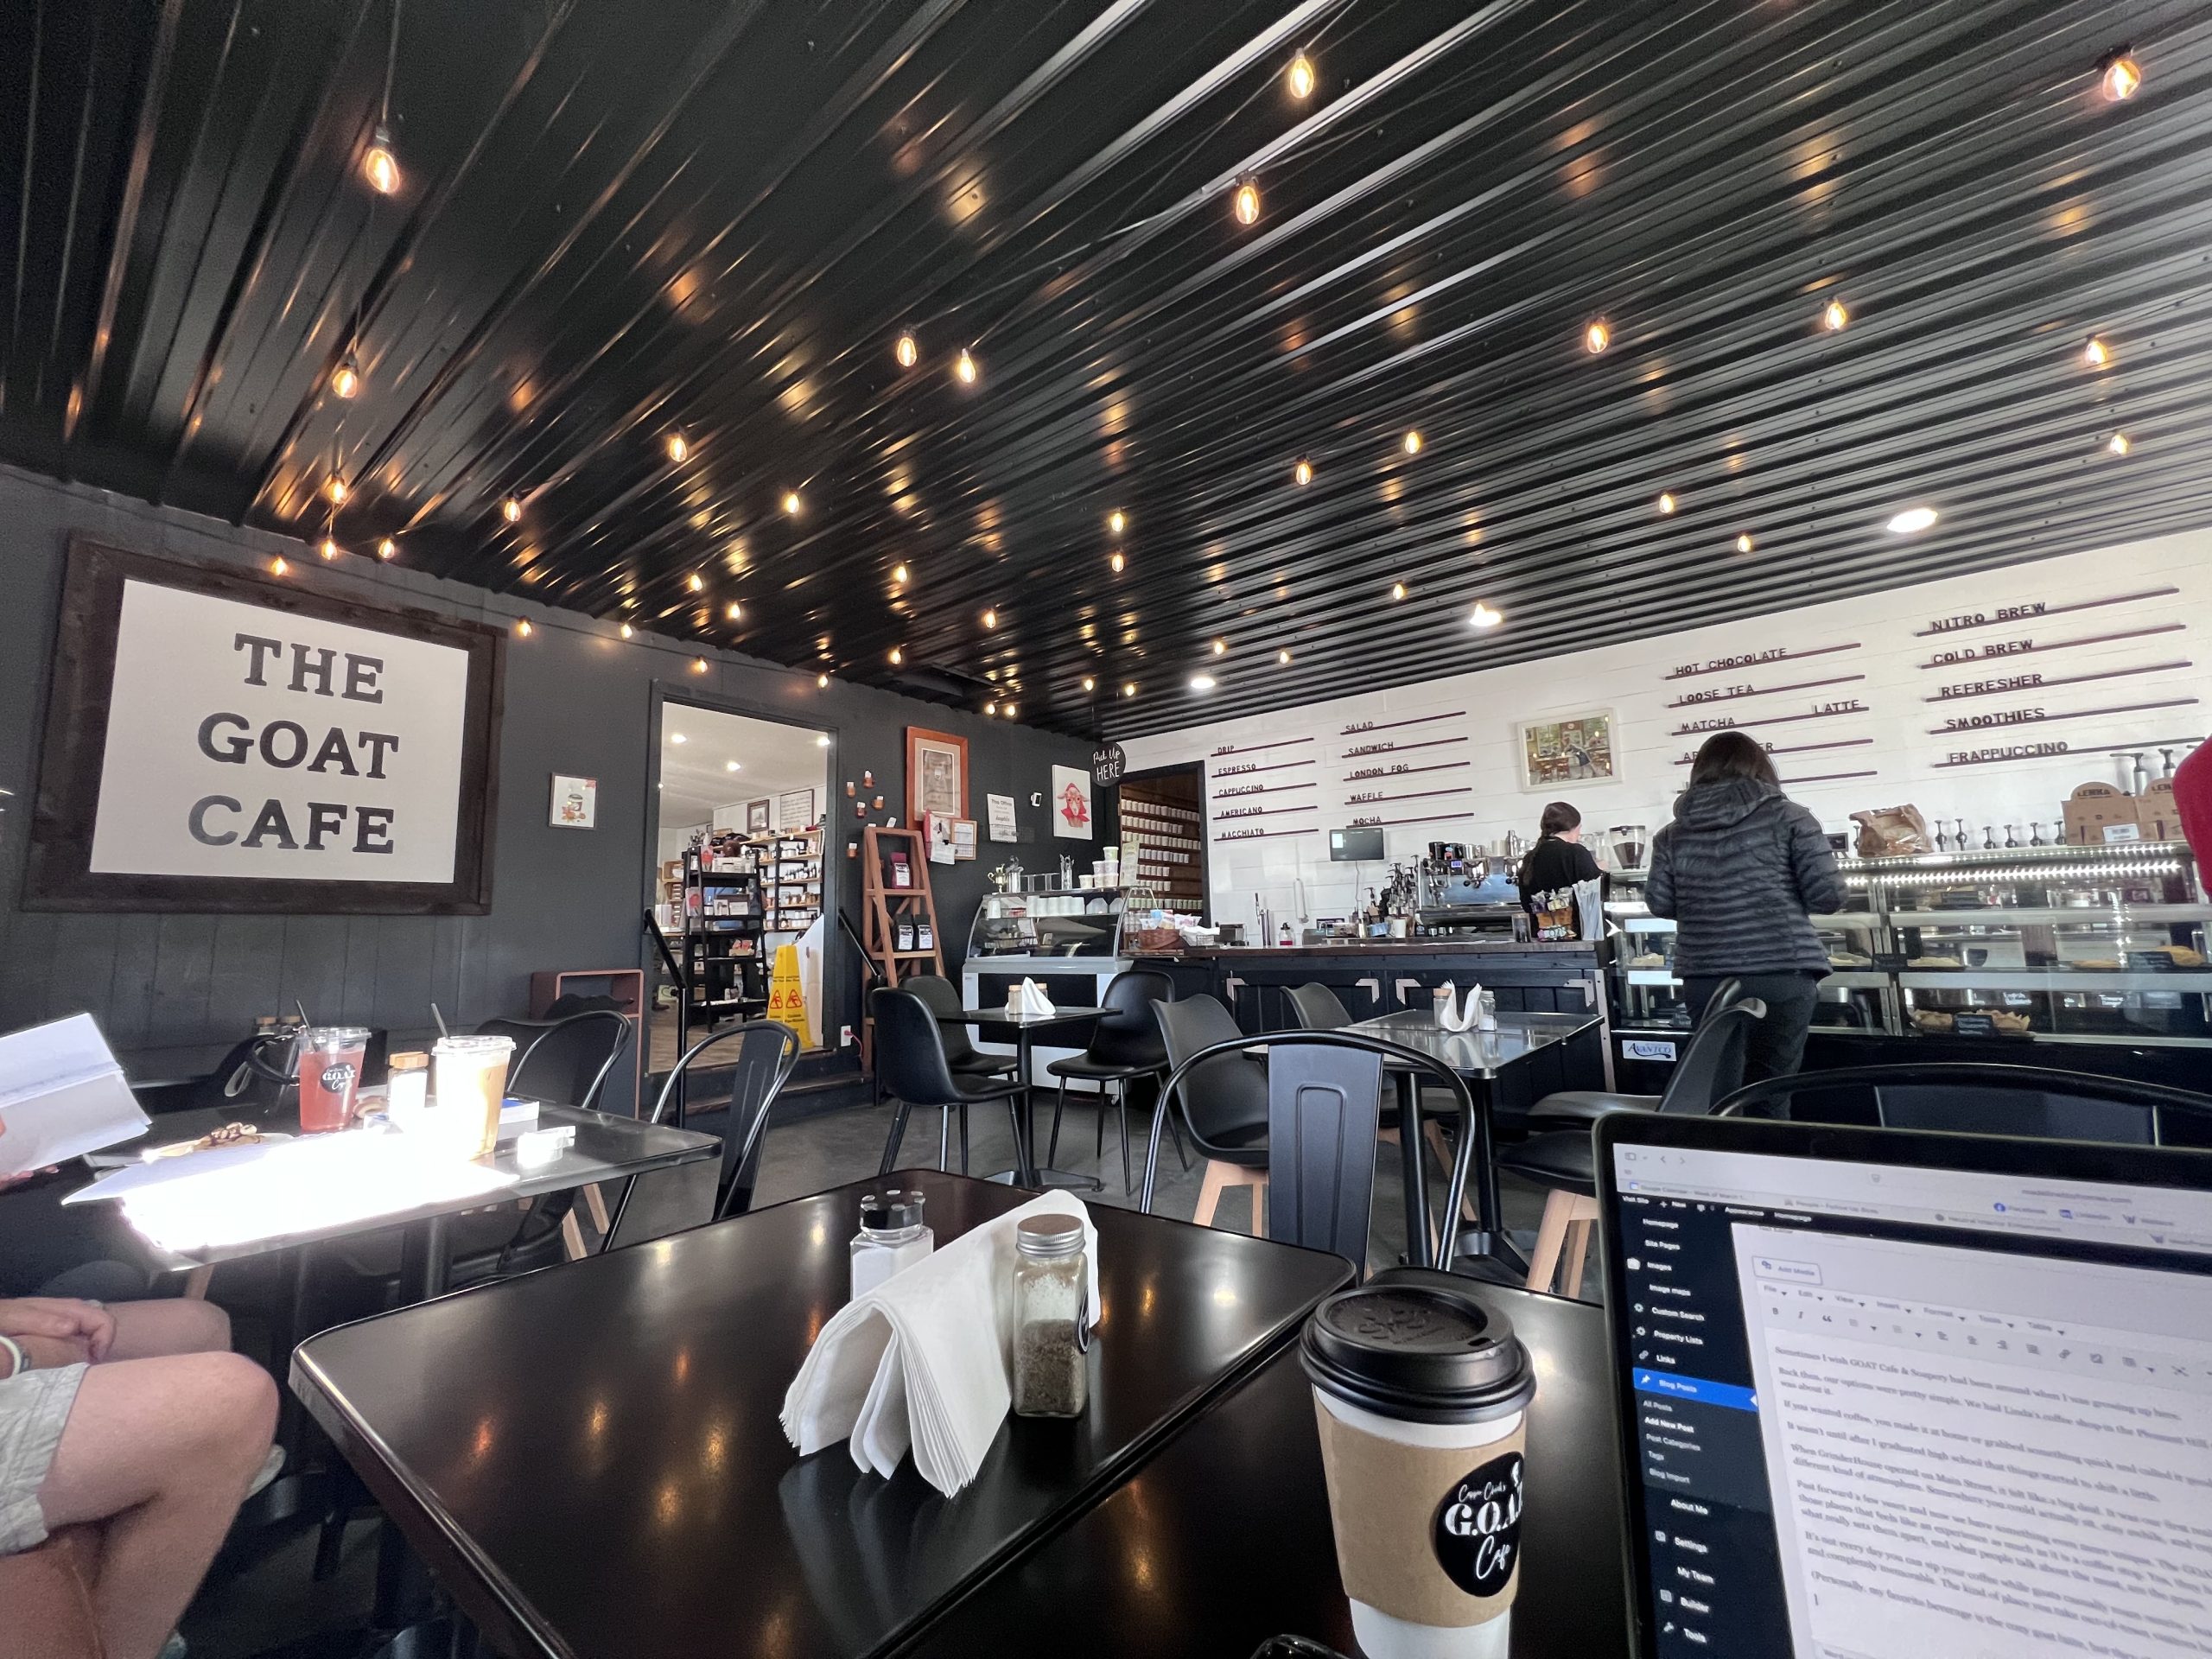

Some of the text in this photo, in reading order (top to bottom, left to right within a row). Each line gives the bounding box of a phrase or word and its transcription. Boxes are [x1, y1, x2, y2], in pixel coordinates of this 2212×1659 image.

[1931, 602, 2046, 632] NITRO BREW
[1933, 639, 2033, 664] COLD BREW
[234, 632, 385, 704] THE
[1675, 648, 1787, 676] HOT CHOCOLATE
[1941, 673, 2043, 697] REFRESHER
[1680, 684, 1754, 704] LOOSE TEA
[1681, 700, 1859, 732] MATCHA LATTE
[1946, 708, 2045, 729] SMOOTHIES
[1345, 721, 1374, 733] SALAD
[198, 713, 399, 779] GOAT
[1217, 745, 1235, 754] DRIP
[1348, 741, 1394, 756] SANDWICH
[1949, 741, 2069, 763] FRAPPUCCINO
[1093, 747, 1121, 765] Pick Up
[1096, 761, 1120, 782] HERE
[1218, 764, 1256, 776] ESPRESSO
[1350, 764, 1409, 779] LONDON FOG
[1218, 784, 1264, 797] CAPPUCCINO
[1350, 791, 1383, 803] WAFFLE
[1220, 806, 1262, 818] AMERICANO
[188, 794, 394, 855] CAFE
[1352, 816, 1382, 826] MOCHA
[1221, 828, 1264, 839] MACCHIATO
[1656, 1354, 1676, 1364] Links
[1827, 1355, 1848, 1365] wish
[1849, 1358, 1877, 1370] GOAT
[1878, 1363, 1898, 1373] Cafe
[1777, 1366, 1798, 1376] Back
[1659, 1379, 1698, 1393] Blog Posts
[1653, 1402, 1673, 1412] Posts
[1791, 1403, 1808, 1413] you
[1644, 1416, 1694, 1433] Add New Post
[1670, 1498, 1709, 1515] About Me
[1674, 1536, 1709, 1554] Settings
[1676, 1566, 1715, 1585] My Team
[1680, 1597, 1710, 1614] Builder
[1683, 1627, 1708, 1643] Tools
